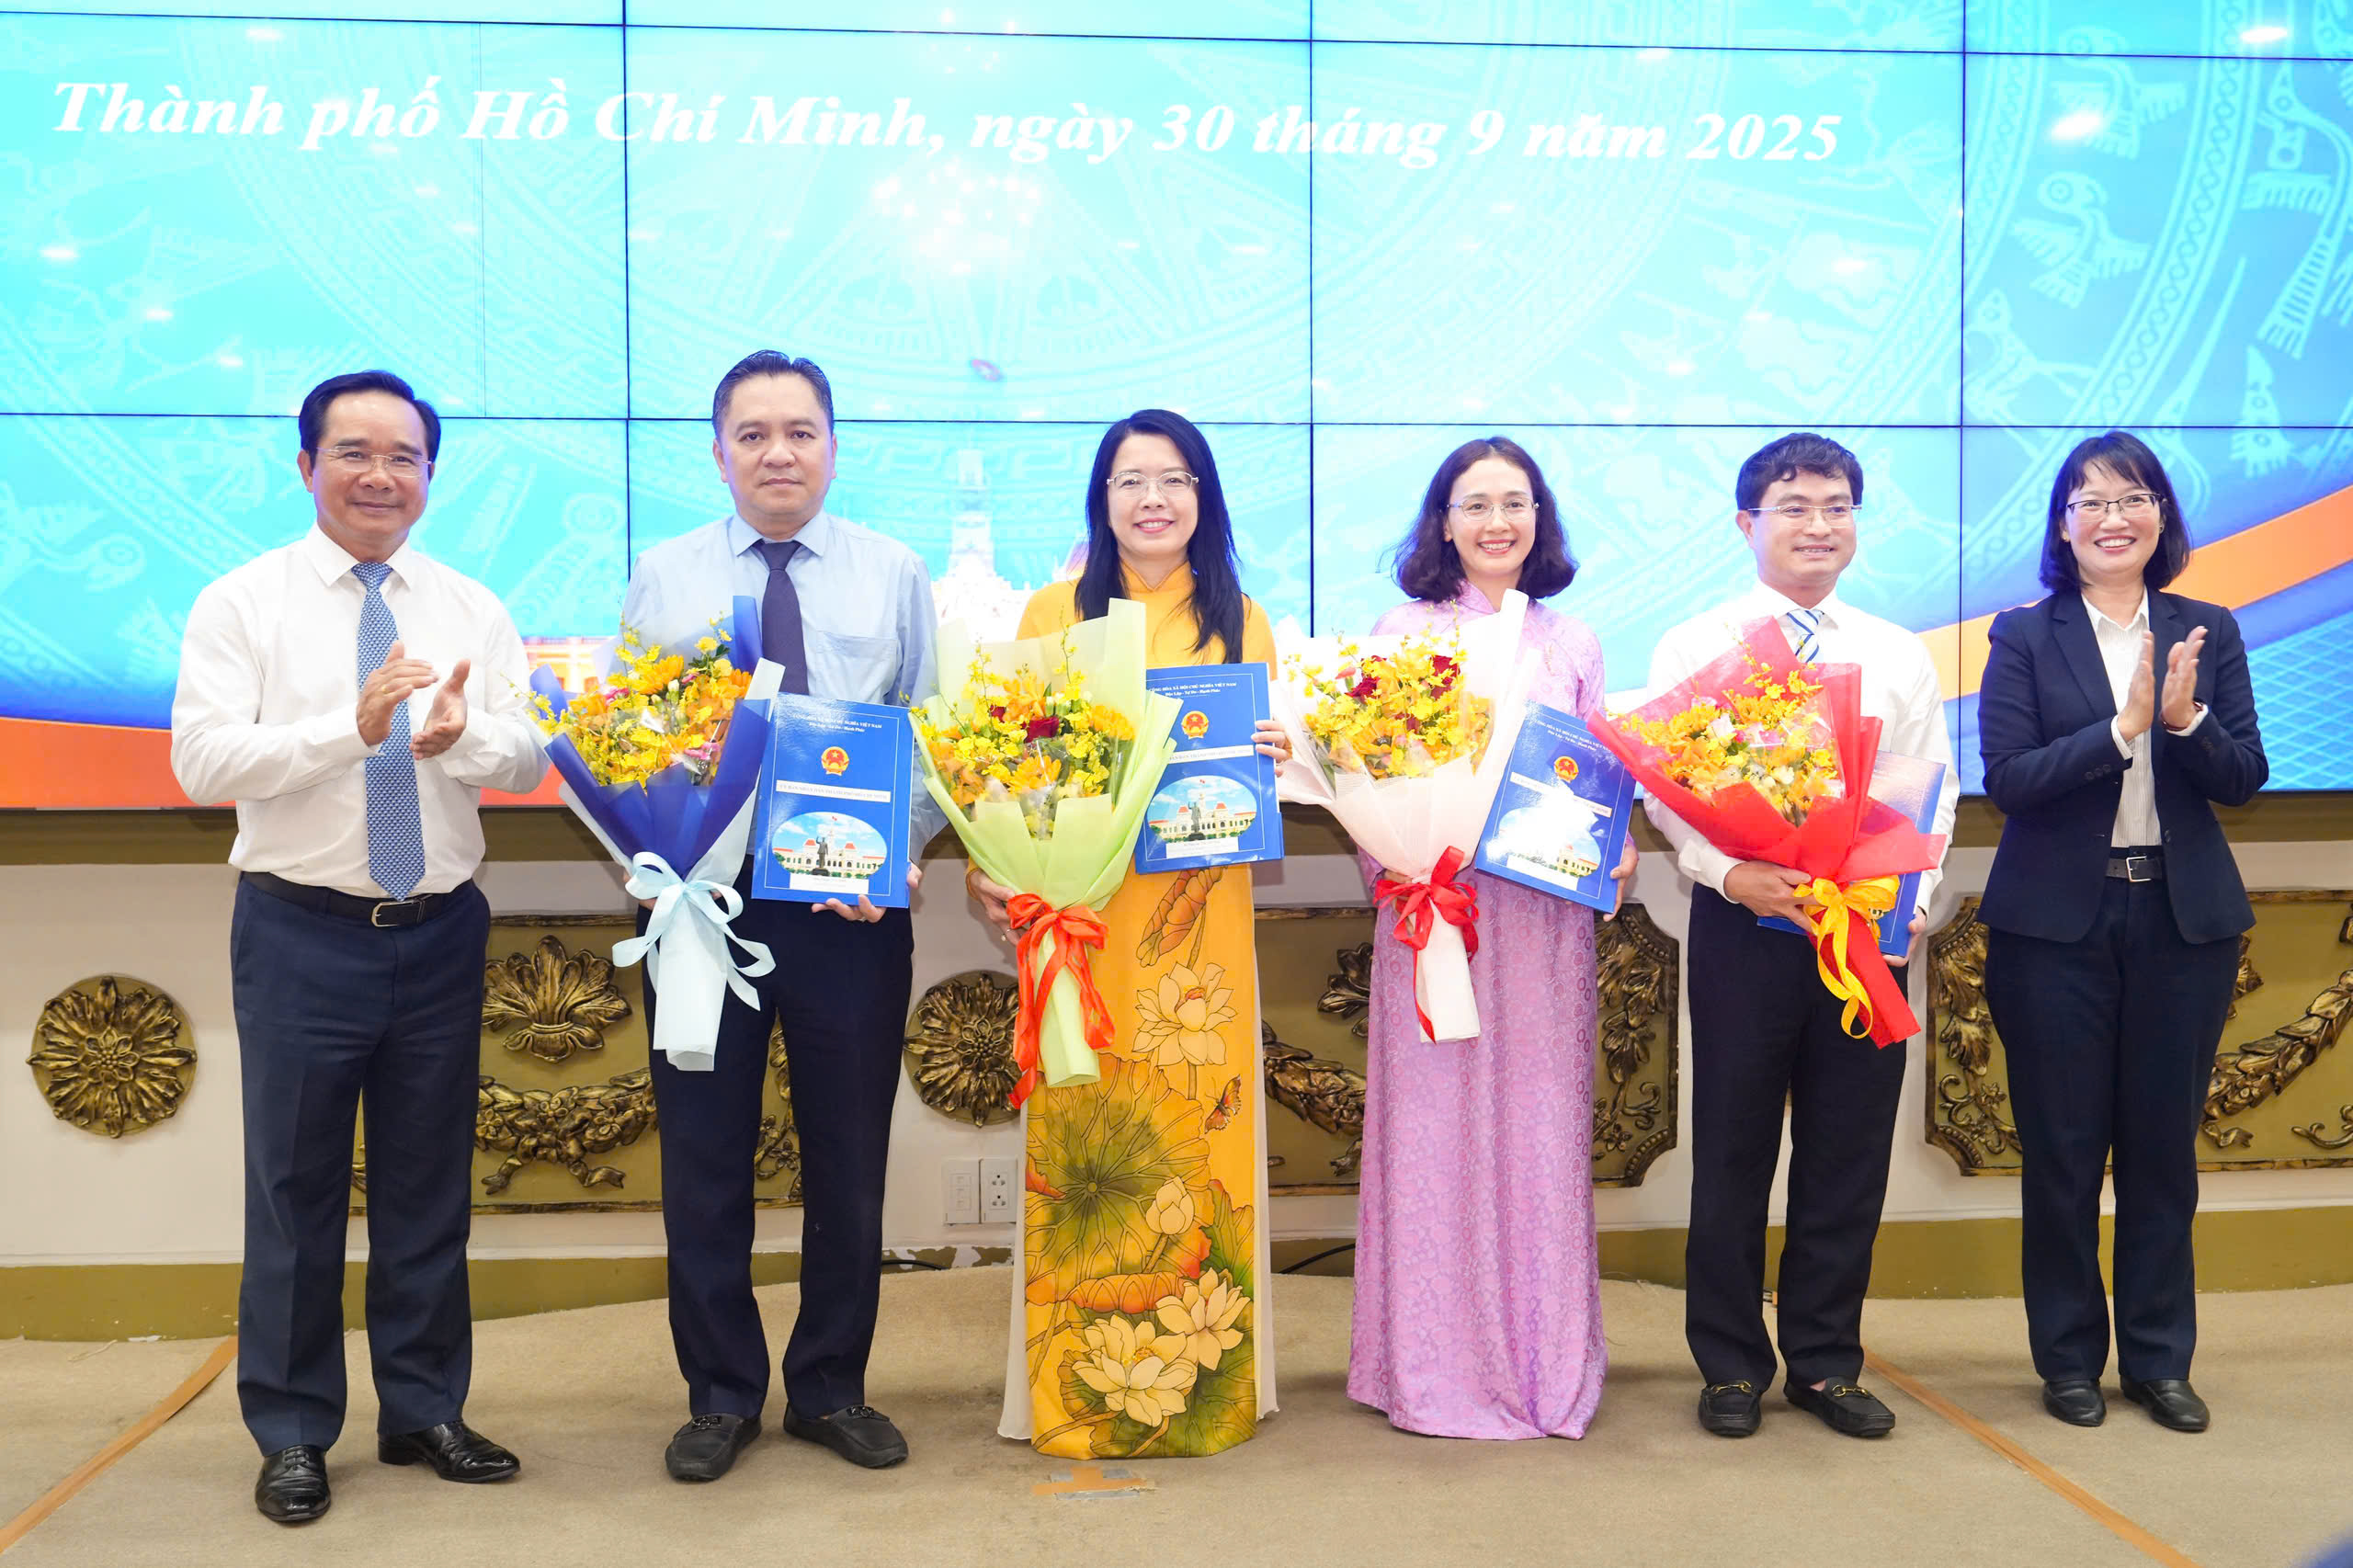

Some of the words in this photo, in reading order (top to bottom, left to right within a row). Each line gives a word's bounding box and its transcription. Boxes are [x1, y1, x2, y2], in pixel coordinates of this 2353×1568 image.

[53, 81, 284, 135] Thành
[299, 75, 442, 151] phố
[460, 77, 569, 141] Hồ
[594, 91, 728, 143] Chí
[736, 95, 945, 156] Minh,
[970, 102, 1133, 165] ngày
[1152, 104, 1235, 152] 30
[1253, 105, 1448, 170] tháng
[1466, 109, 1506, 155] 9
[1521, 111, 1666, 159] năm
[1685, 113, 1841, 161] 2025
